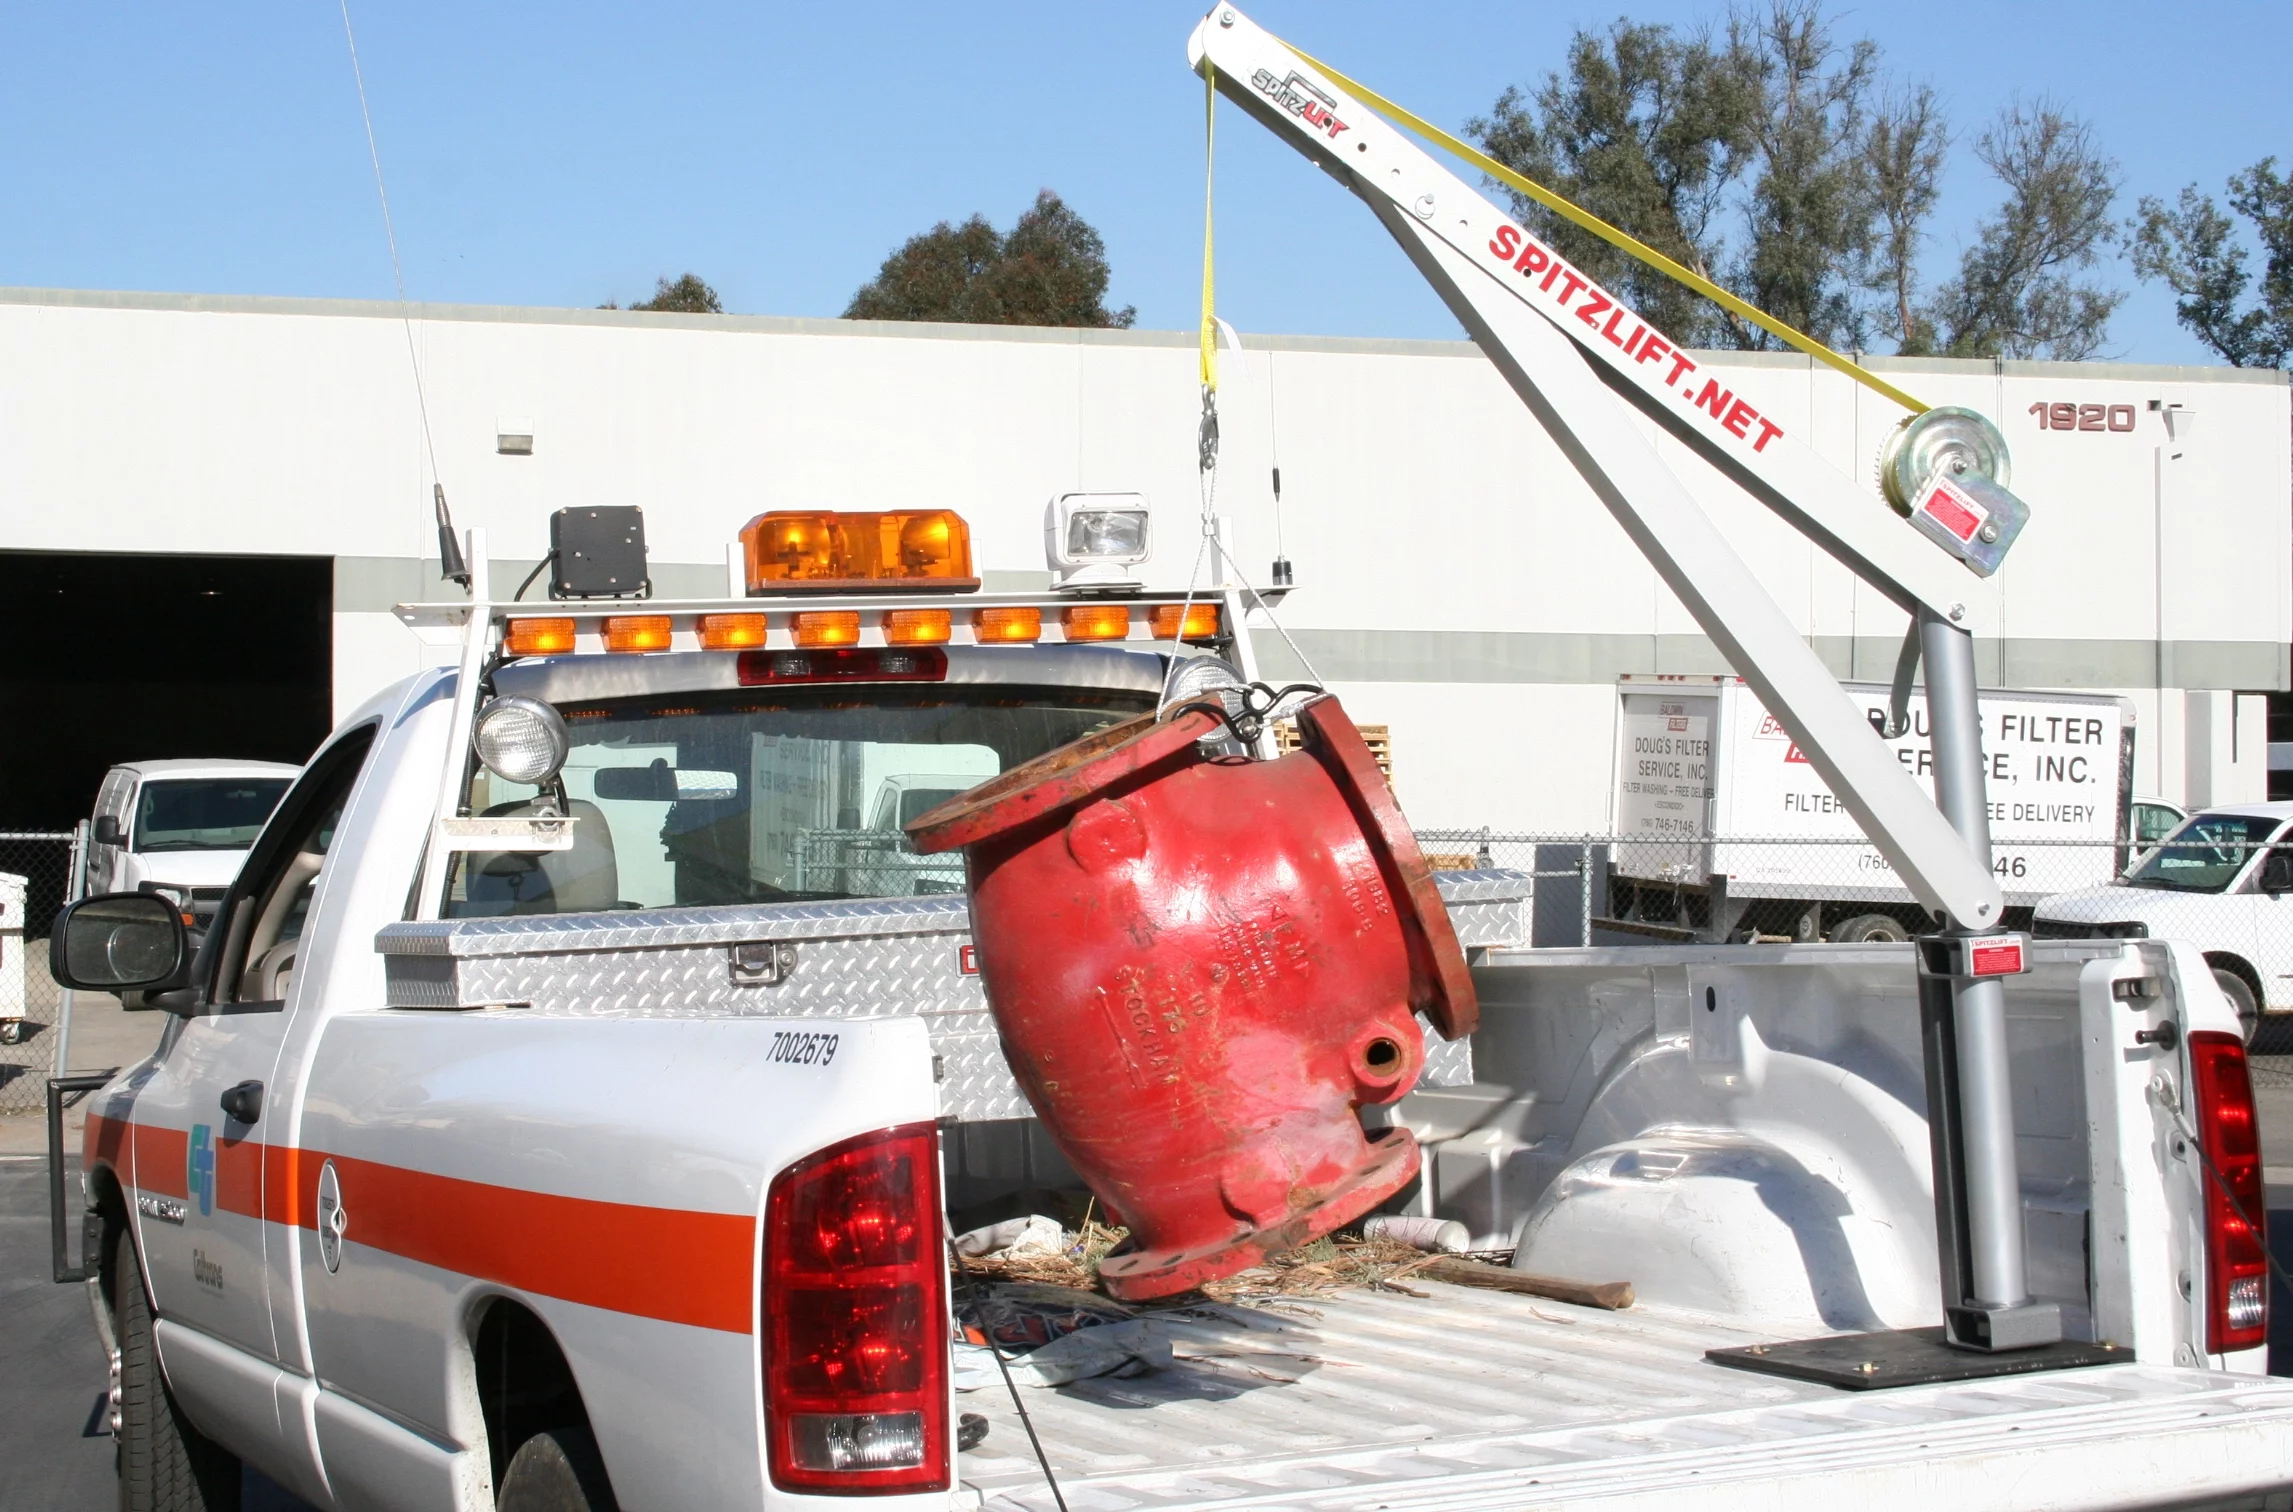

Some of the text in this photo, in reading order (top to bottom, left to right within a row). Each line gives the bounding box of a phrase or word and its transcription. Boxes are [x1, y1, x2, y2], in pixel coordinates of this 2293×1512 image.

[1489, 225, 1784, 453] SPITZLIFT.NET
[2028, 402, 2135, 432] 1920
[2001, 714, 2103, 745] FILTER
[1635, 736, 1710, 757] DOUG'S FILTER
[1638, 760, 1709, 781] SERVICE, INC.
[2036, 755, 2096, 784] INC.
[1623, 782, 1641, 794] FILTER
[1642, 784, 1668, 796] WASHING
[1675, 786, 1690, 798] FREE
[1690, 787, 1715, 800] DELIVER
[1785, 793, 1845, 814] FILTER
[2013, 803, 2096, 823] DELIVERY
[1655, 817, 1694, 834] 746-7146
[1858, 854, 1895, 872] (760
[766, 1031, 840, 1067] 7002679
